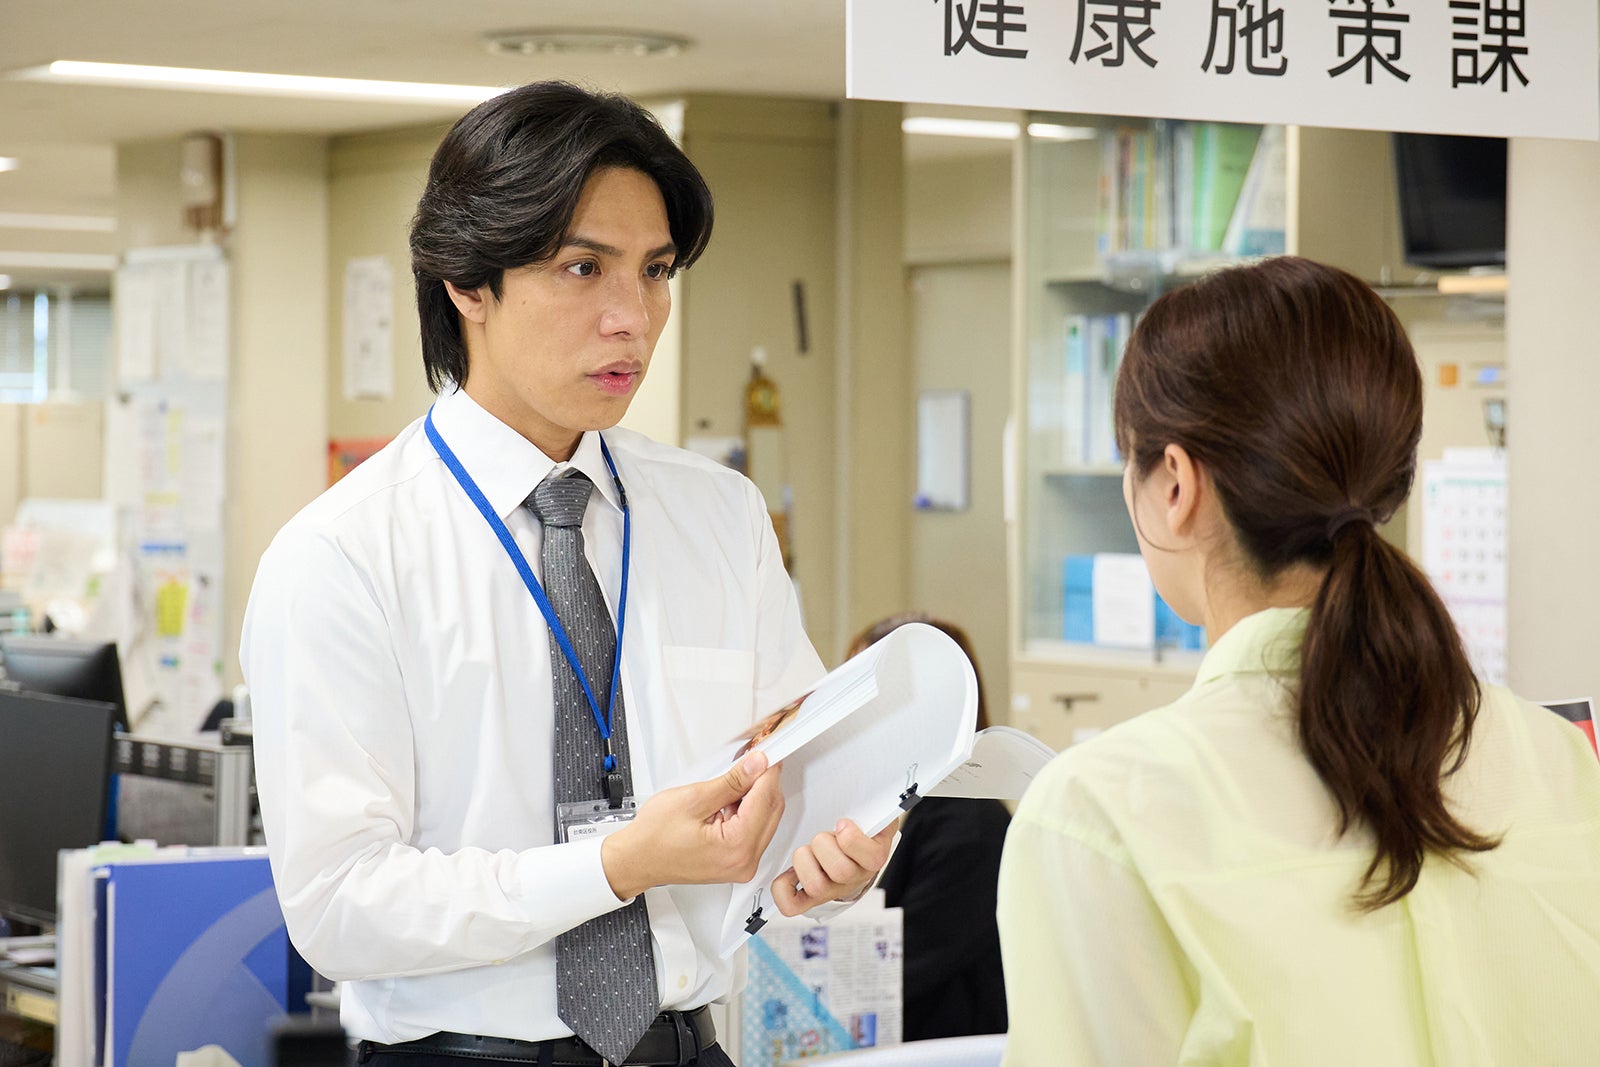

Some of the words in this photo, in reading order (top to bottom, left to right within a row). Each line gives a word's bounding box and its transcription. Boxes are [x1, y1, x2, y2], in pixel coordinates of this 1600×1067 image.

[935, 0, 1530, 92] 健康施策課
